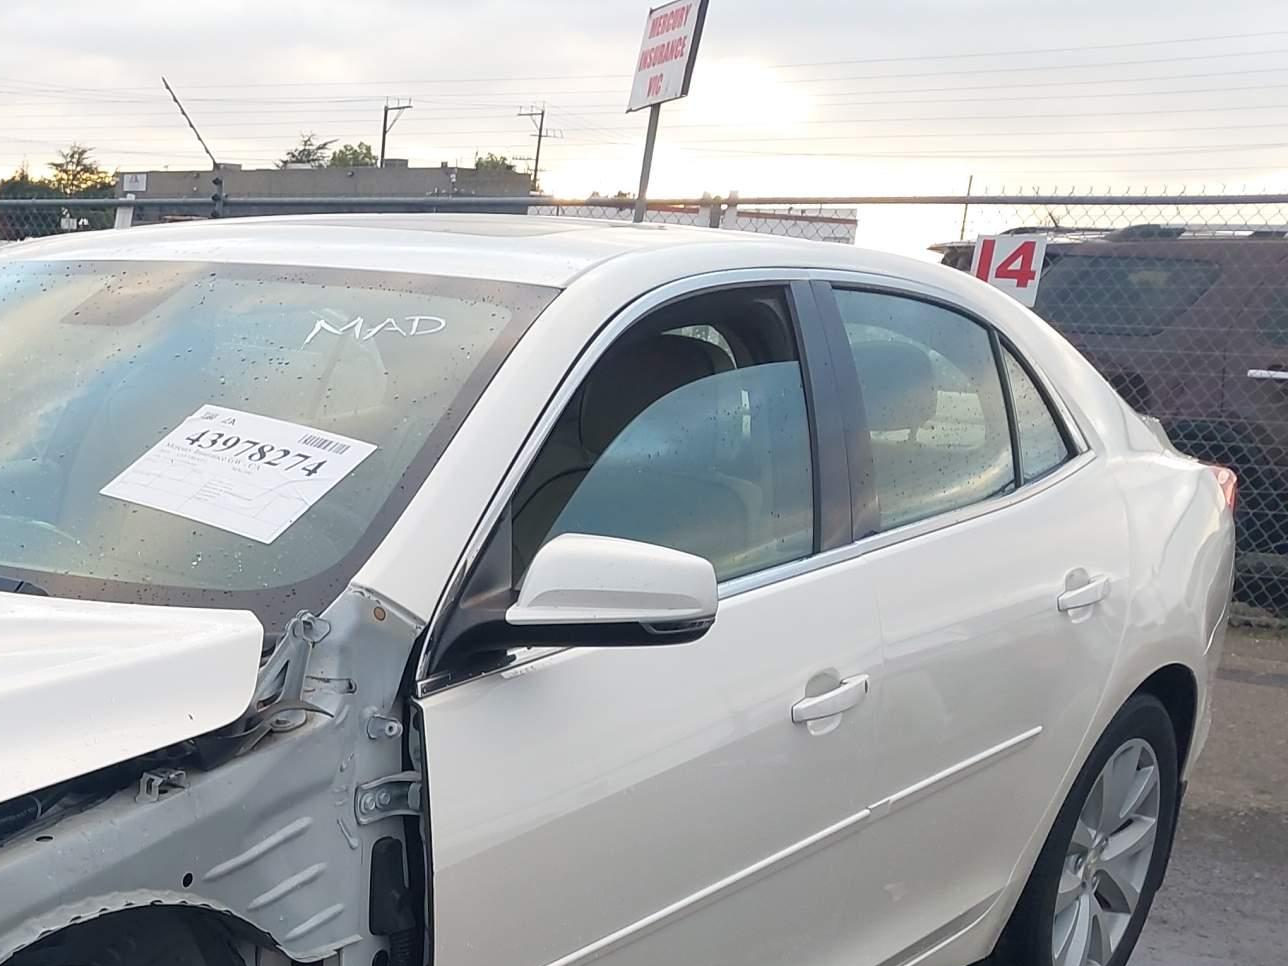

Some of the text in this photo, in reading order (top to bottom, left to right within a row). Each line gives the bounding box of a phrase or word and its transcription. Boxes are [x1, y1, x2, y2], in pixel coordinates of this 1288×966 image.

[648, 3, 693, 39] MERCURY
[638, 36, 688, 72] INSURANCE
[975, 238, 1037, 289] 14
[301, 315, 447, 349] MAD
[184, 428, 328, 477] 43978274
